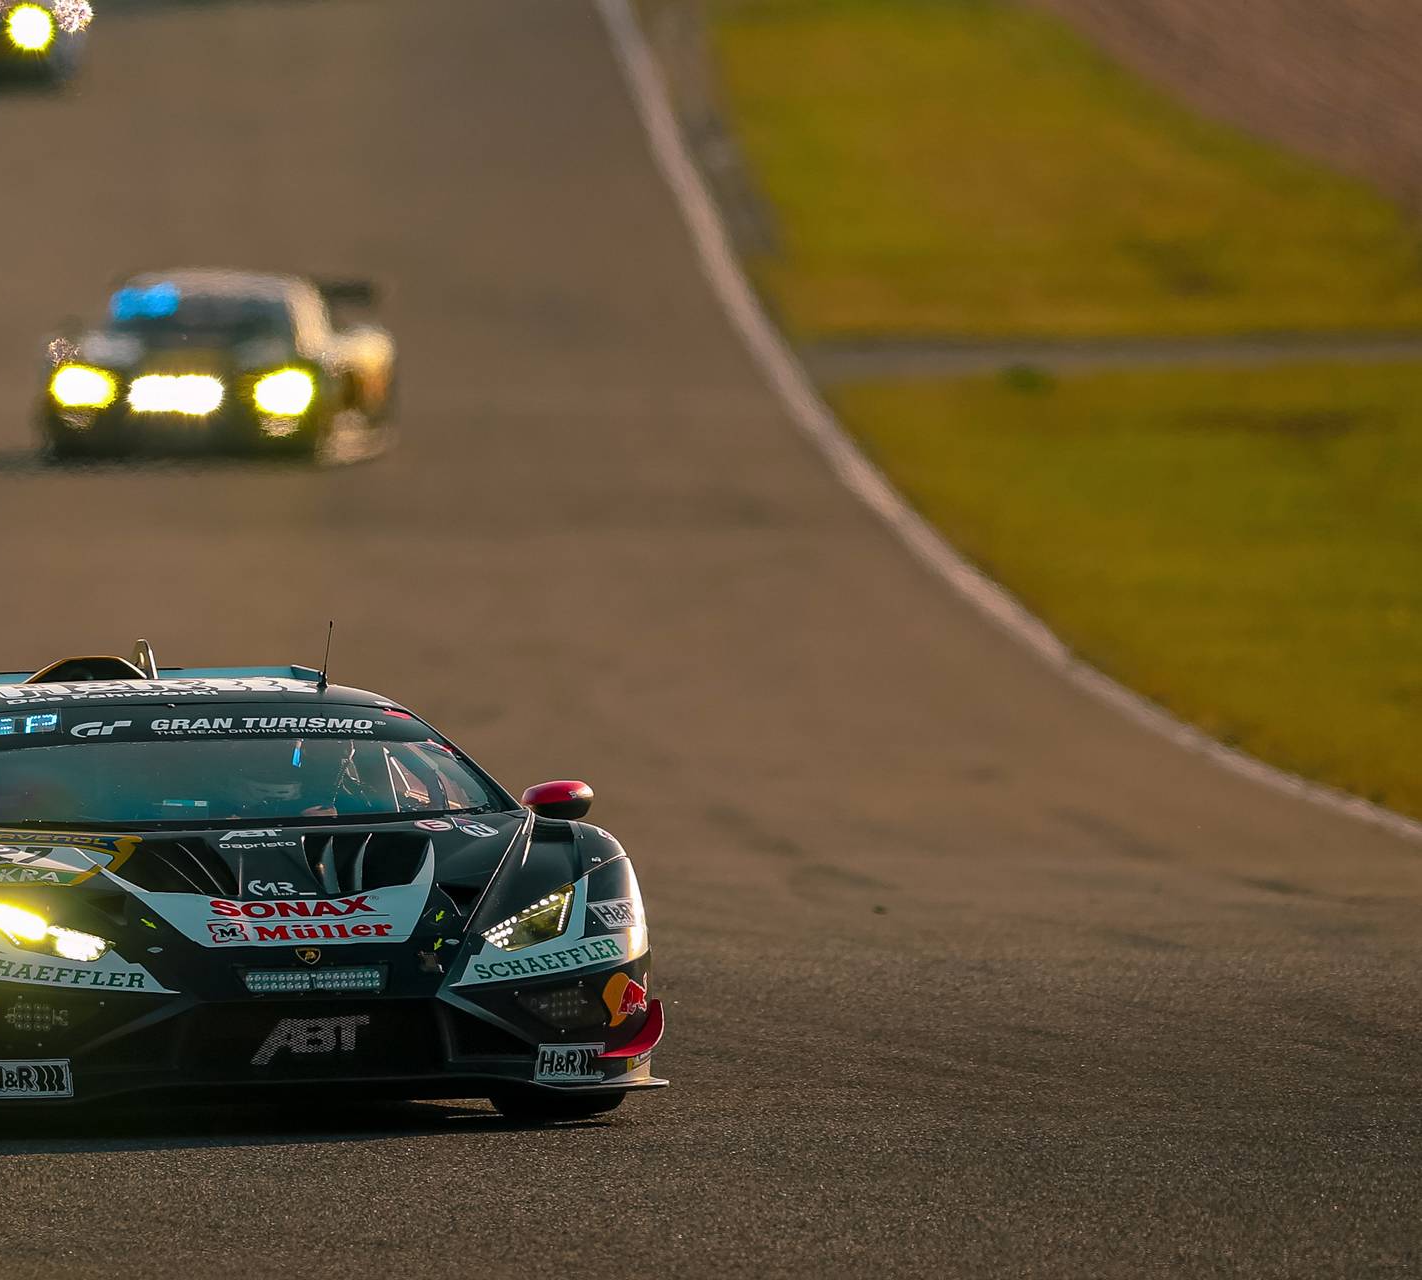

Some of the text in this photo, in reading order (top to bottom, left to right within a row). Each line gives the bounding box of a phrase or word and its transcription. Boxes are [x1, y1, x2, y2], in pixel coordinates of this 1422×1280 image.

[150, 717, 374, 731] GRAN TURISMO
[291, 727, 374, 735] SIMULATOR
[219, 829, 283, 841] ABT
[210, 896, 376, 919] SONAX
[254, 922, 394, 941] Müller
[474, 938, 623, 980] SCHAEFFLER
[250, 1015, 371, 1065] ABT
[539, 1050, 577, 1076] H&R
